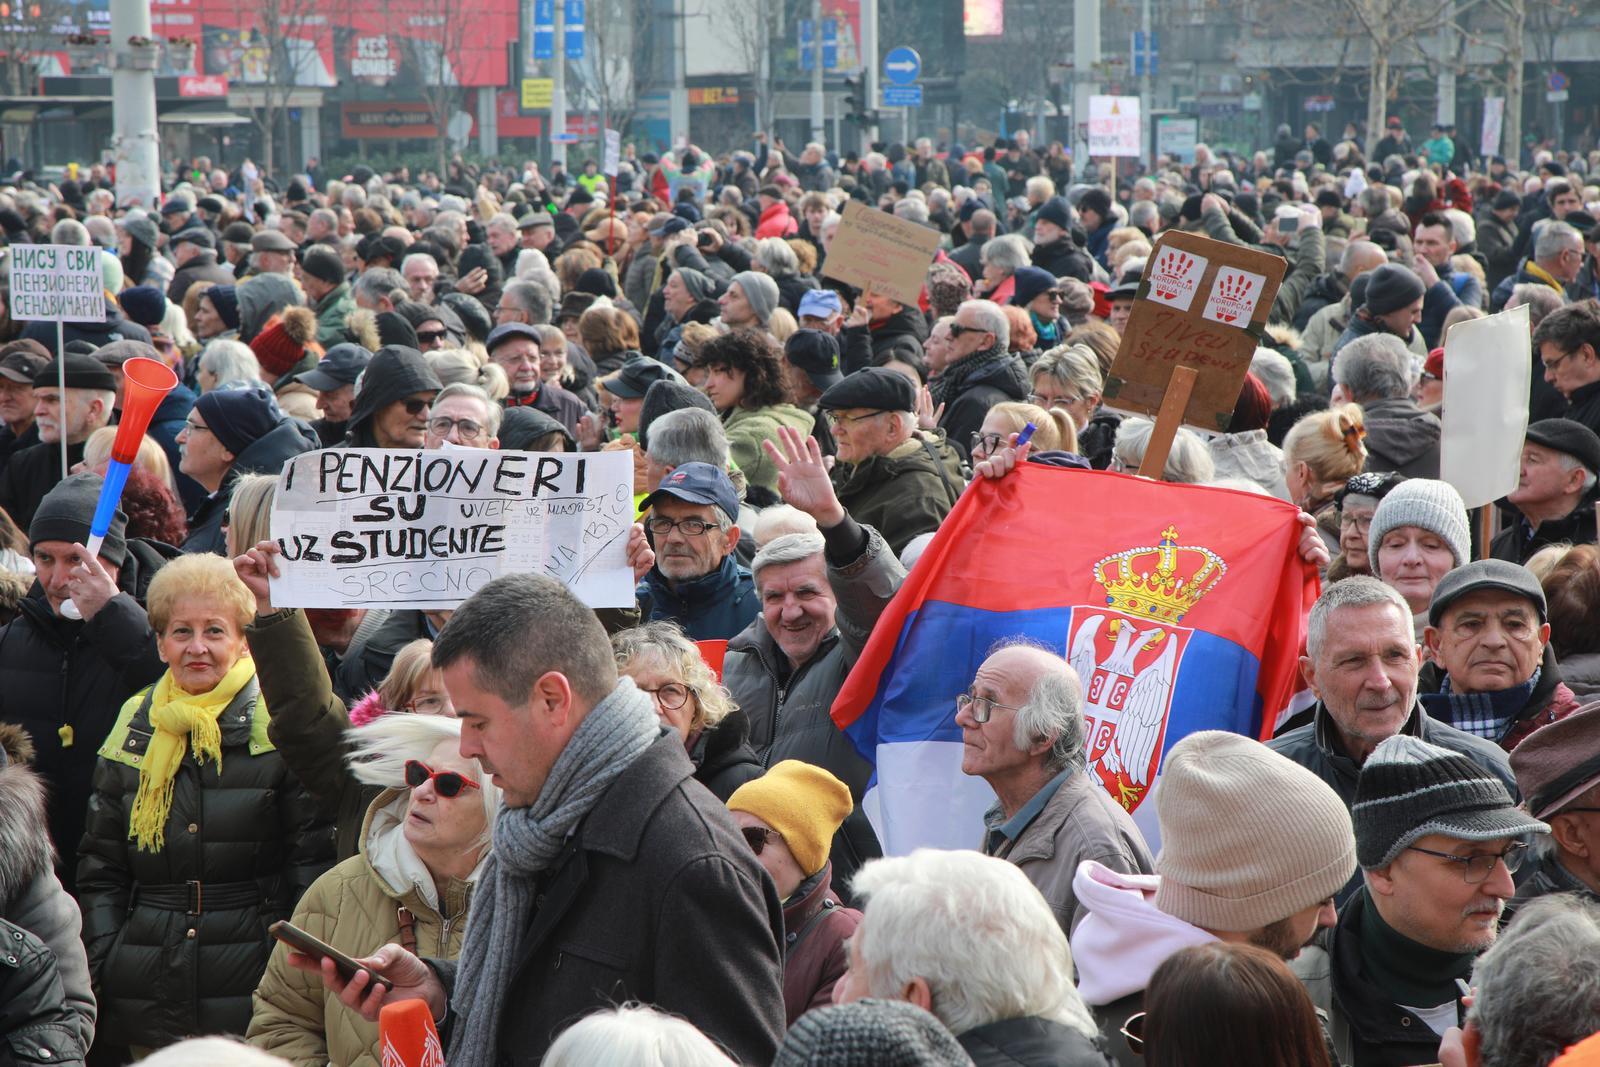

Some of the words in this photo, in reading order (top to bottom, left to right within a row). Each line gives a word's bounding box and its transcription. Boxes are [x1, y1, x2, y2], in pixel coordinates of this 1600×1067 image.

[13, 248, 57, 270] НИСУ
[66, 250, 96, 272] СВИ
[13, 272, 100, 294] ПЕНЗИОНЕРИ
[1151, 273, 1193, 292] KORUPCIJA
[14, 294, 104, 318] СЕНДВИЧАРИ!
[1210, 295, 1253, 312] KORUPCIJA
[285, 458, 296, 492] I
[352, 494, 427, 522] SU
[460, 500, 513, 519] UVEK
[277, 534, 324, 562] UZ
[330, 524, 506, 564] STUDENTE
